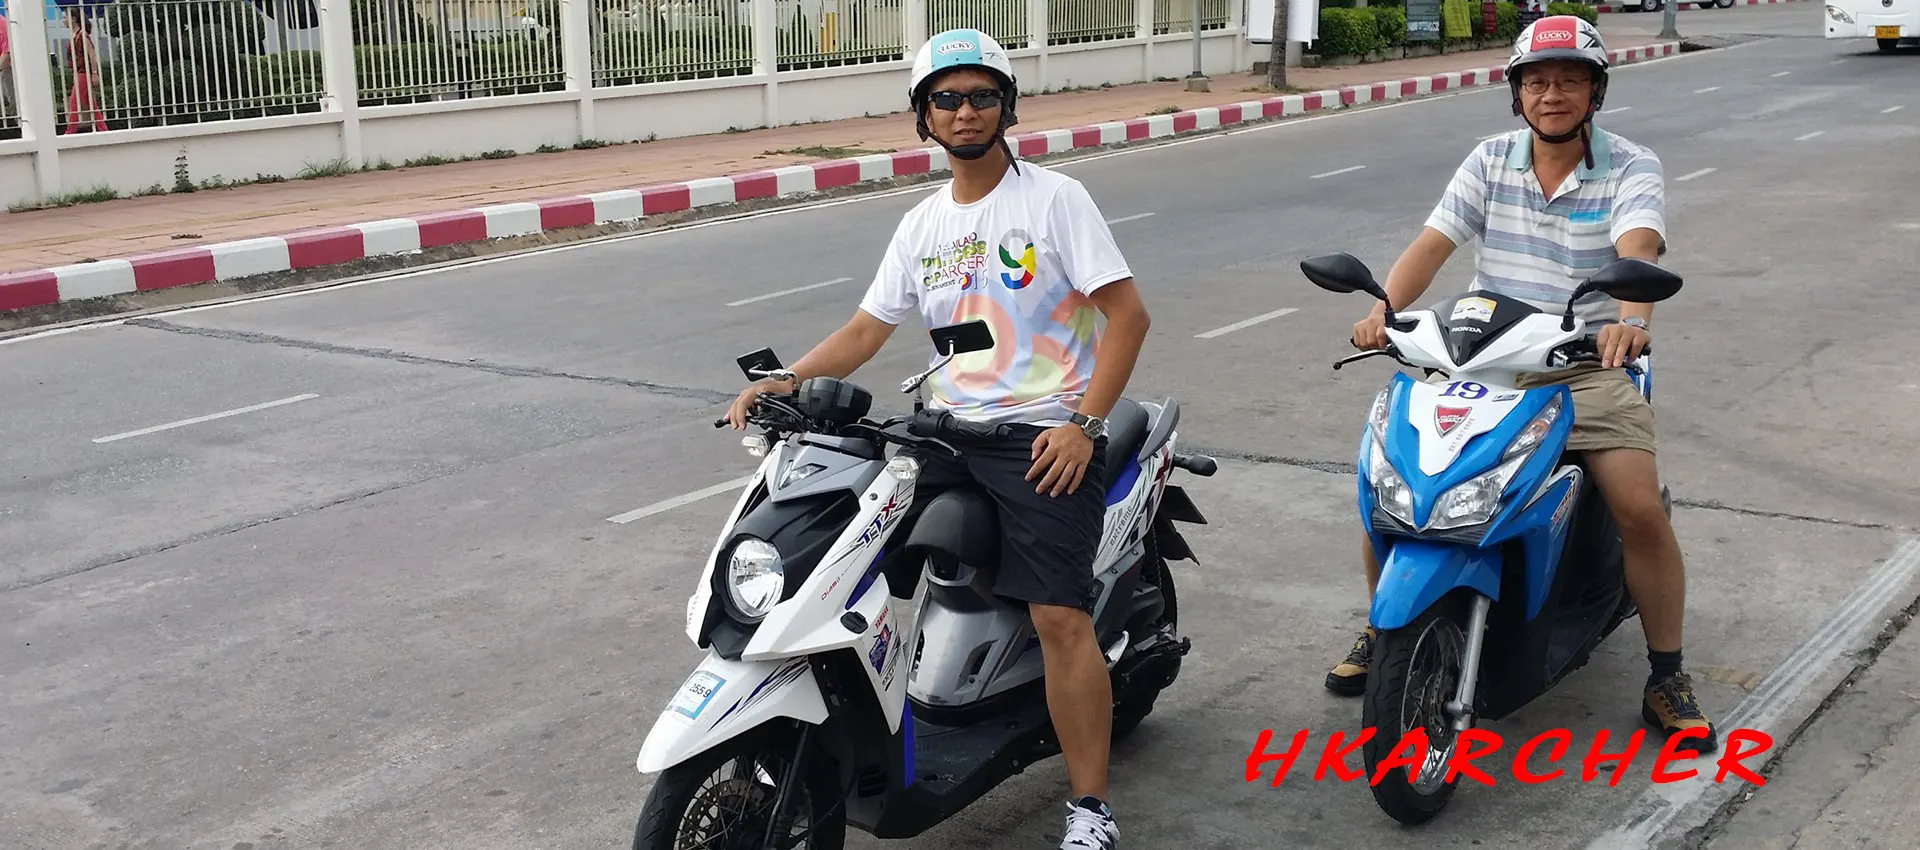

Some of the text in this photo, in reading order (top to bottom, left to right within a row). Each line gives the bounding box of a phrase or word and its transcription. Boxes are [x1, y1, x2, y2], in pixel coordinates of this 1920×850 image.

[1539, 31, 1570, 41] LUCKY
[941, 42, 971, 52] LUCKY
[1451, 326, 1483, 335] HONDA
[1438, 380, 1489, 400] 19
